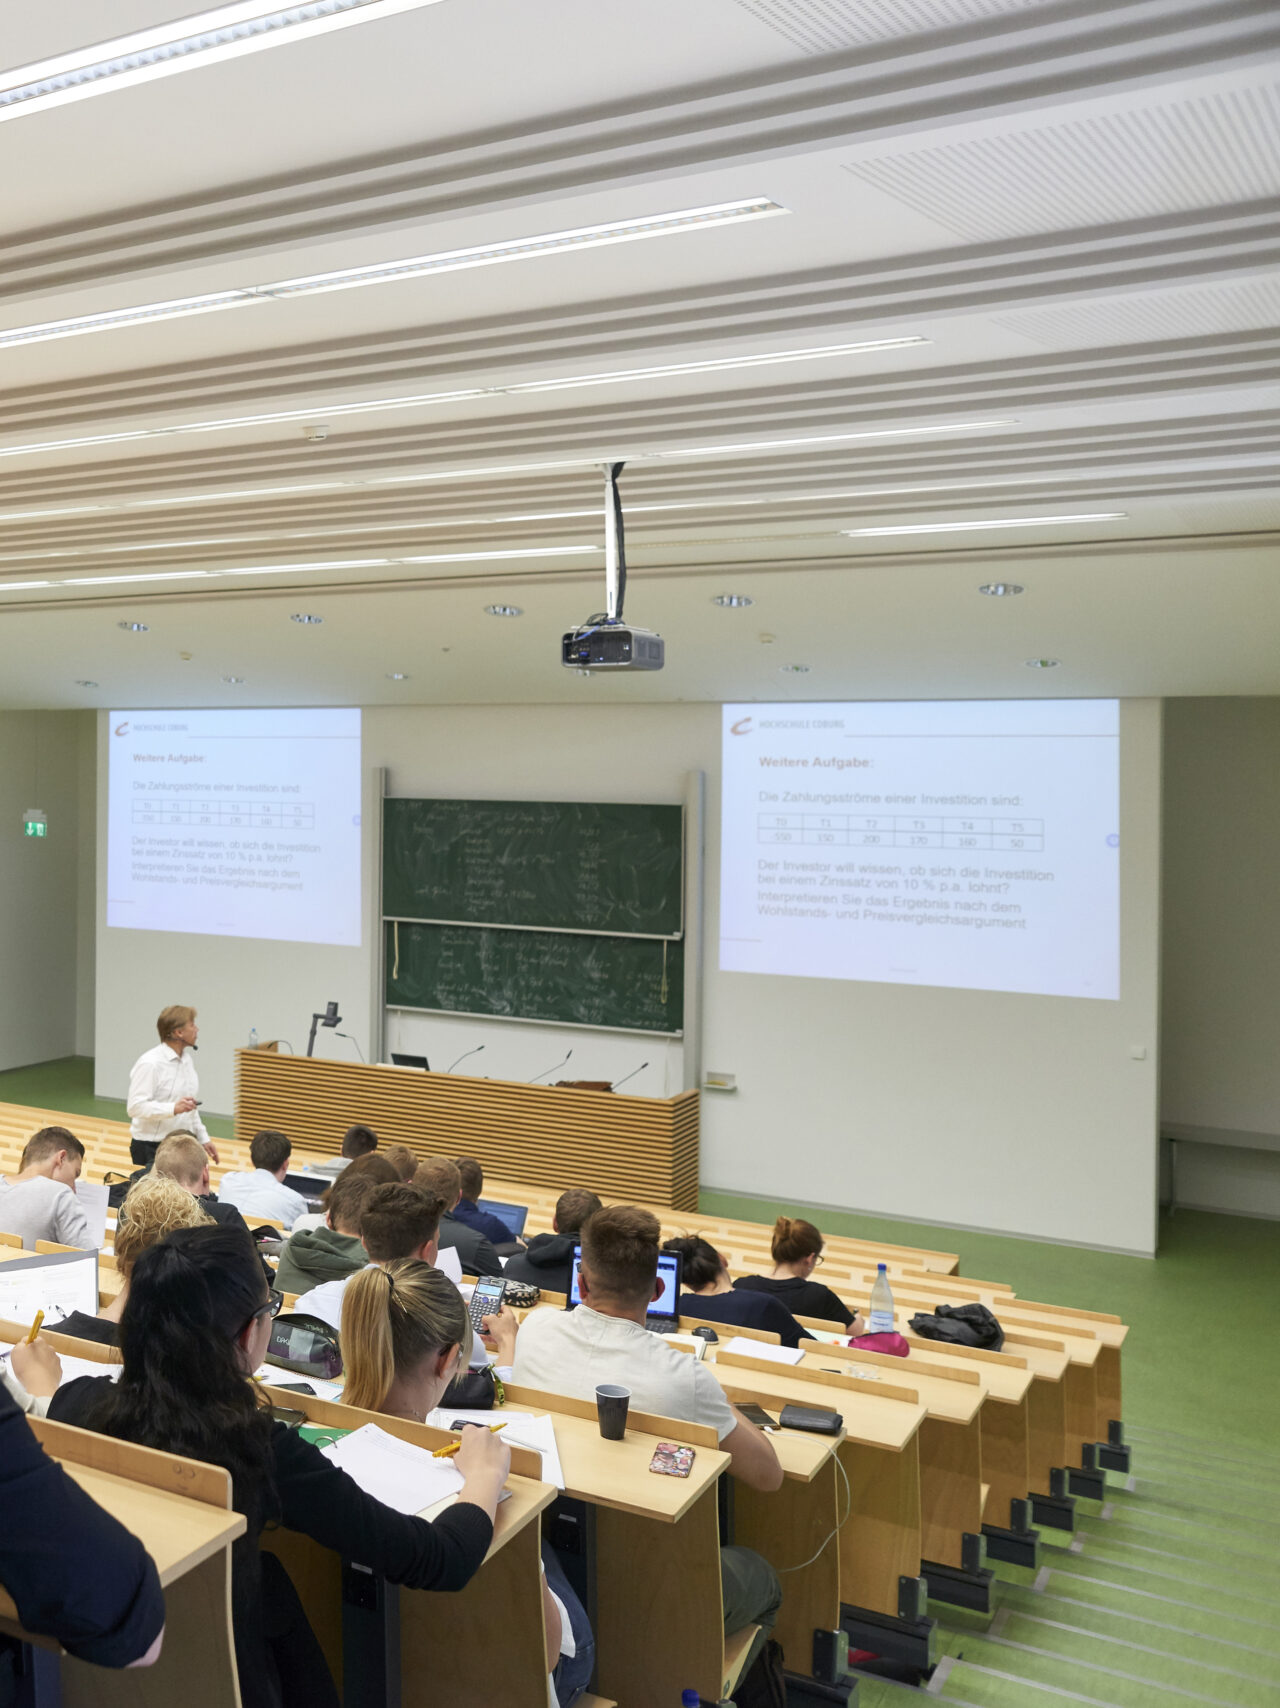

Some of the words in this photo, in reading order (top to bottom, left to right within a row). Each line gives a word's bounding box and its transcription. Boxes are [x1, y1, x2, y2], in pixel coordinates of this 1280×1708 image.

[133, 753, 165, 762] Weitere
[759, 757, 809, 768] Weitere
[812, 757, 874, 770] Aufgabe:
[759, 791, 779, 802] Die
[782, 791, 881, 805] Zahlungsströme
[885, 794, 917, 804] einer
[921, 794, 988, 805] Investition
[775, 817, 787, 826] T0
[820, 818, 831, 827] T1
[866, 819, 878, 828] T2
[913, 820, 926, 830] T3
[961, 821, 974, 831] T4
[1011, 823, 1024, 832] T5
[863, 834, 880, 843] 200
[910, 836, 928, 845] 170
[1010, 839, 1024, 848] 50
[226, 851, 236, 860] 10
[758, 859, 779, 870] Der
[784, 860, 831, 872] Investor
[835, 862, 855, 873] will
[909, 866, 926, 876] ob
[930, 866, 956, 877] sich
[960, 867, 980, 878] die
[985, 868, 1055, 882] Investition
[758, 873, 776, 884] bei
[779, 875, 816, 885] einem
[820, 875, 871, 888] Zinssatz
[875, 879, 898, 889] von
[904, 879, 919, 890] 10
[923, 880, 935, 890] %
[940, 882, 962, 893] p.a.
[969, 881, 1010, 894] lohnt?
[758, 891, 838, 904] Interpretieren
[842, 894, 862, 905] Sie
[866, 895, 889, 906] das
[893, 896, 950, 910] Ergebnis
[955, 899, 987, 911] nach
[991, 901, 1021, 913] dem
[758, 904, 832, 918] Wohlstands-
[836, 908, 859, 919] und
[863, 908, 1026, 930] Preisvergleichsargument
